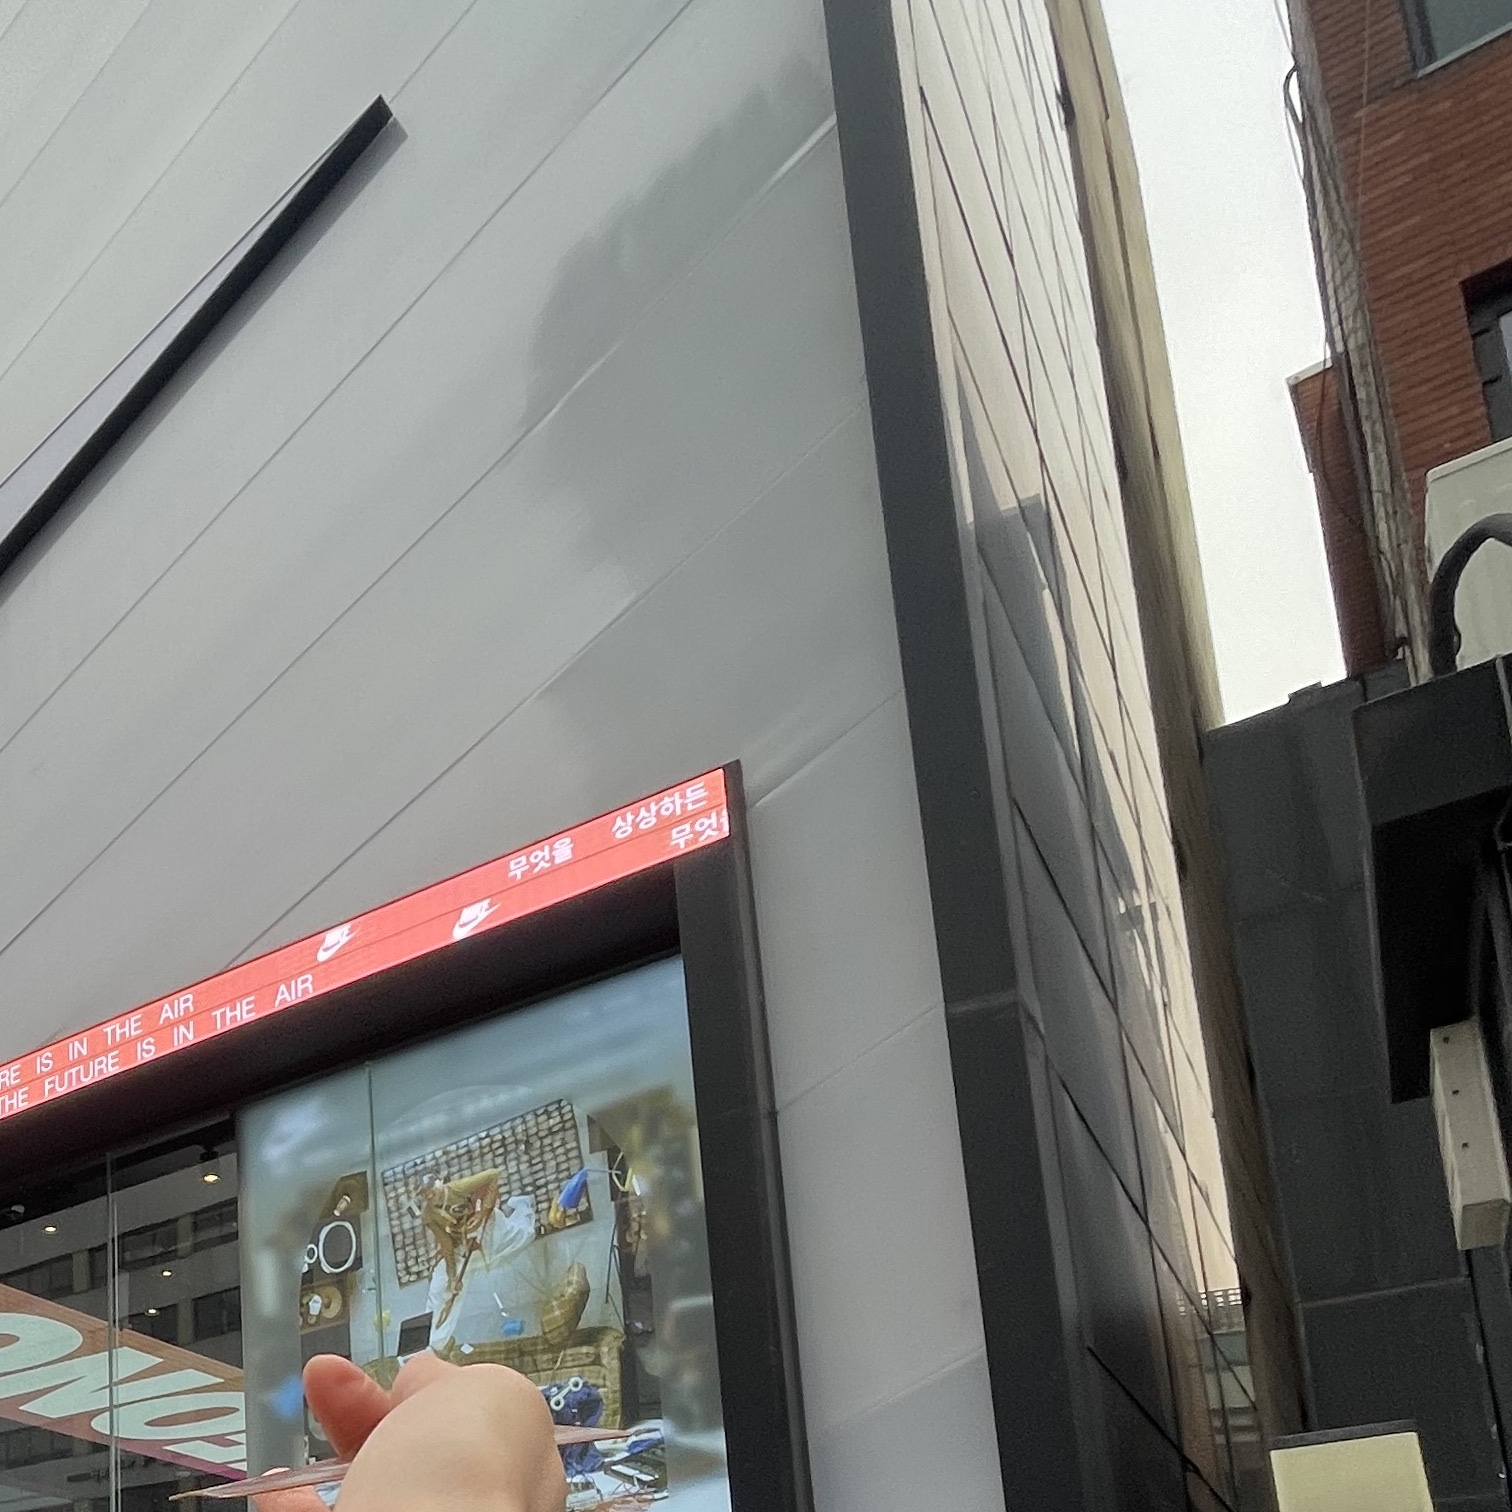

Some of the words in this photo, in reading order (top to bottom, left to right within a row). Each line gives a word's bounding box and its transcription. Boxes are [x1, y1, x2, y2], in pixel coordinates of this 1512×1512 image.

[508, 836, 573, 880] 무엇을
[612, 781, 708, 839] 상상하든
[35, 1052, 53, 1074] IS
[68, 1037, 88, 1061] IN
[103, 1014, 142, 1046] THE
[159, 993, 194, 1025] AIR
[44, 1050, 120, 1098] FUTURE
[136, 1037, 156, 1061] IS
[173, 1020, 194, 1047] IN
[212, 995, 256, 1030] THE
[274, 973, 313, 1008] AIR
